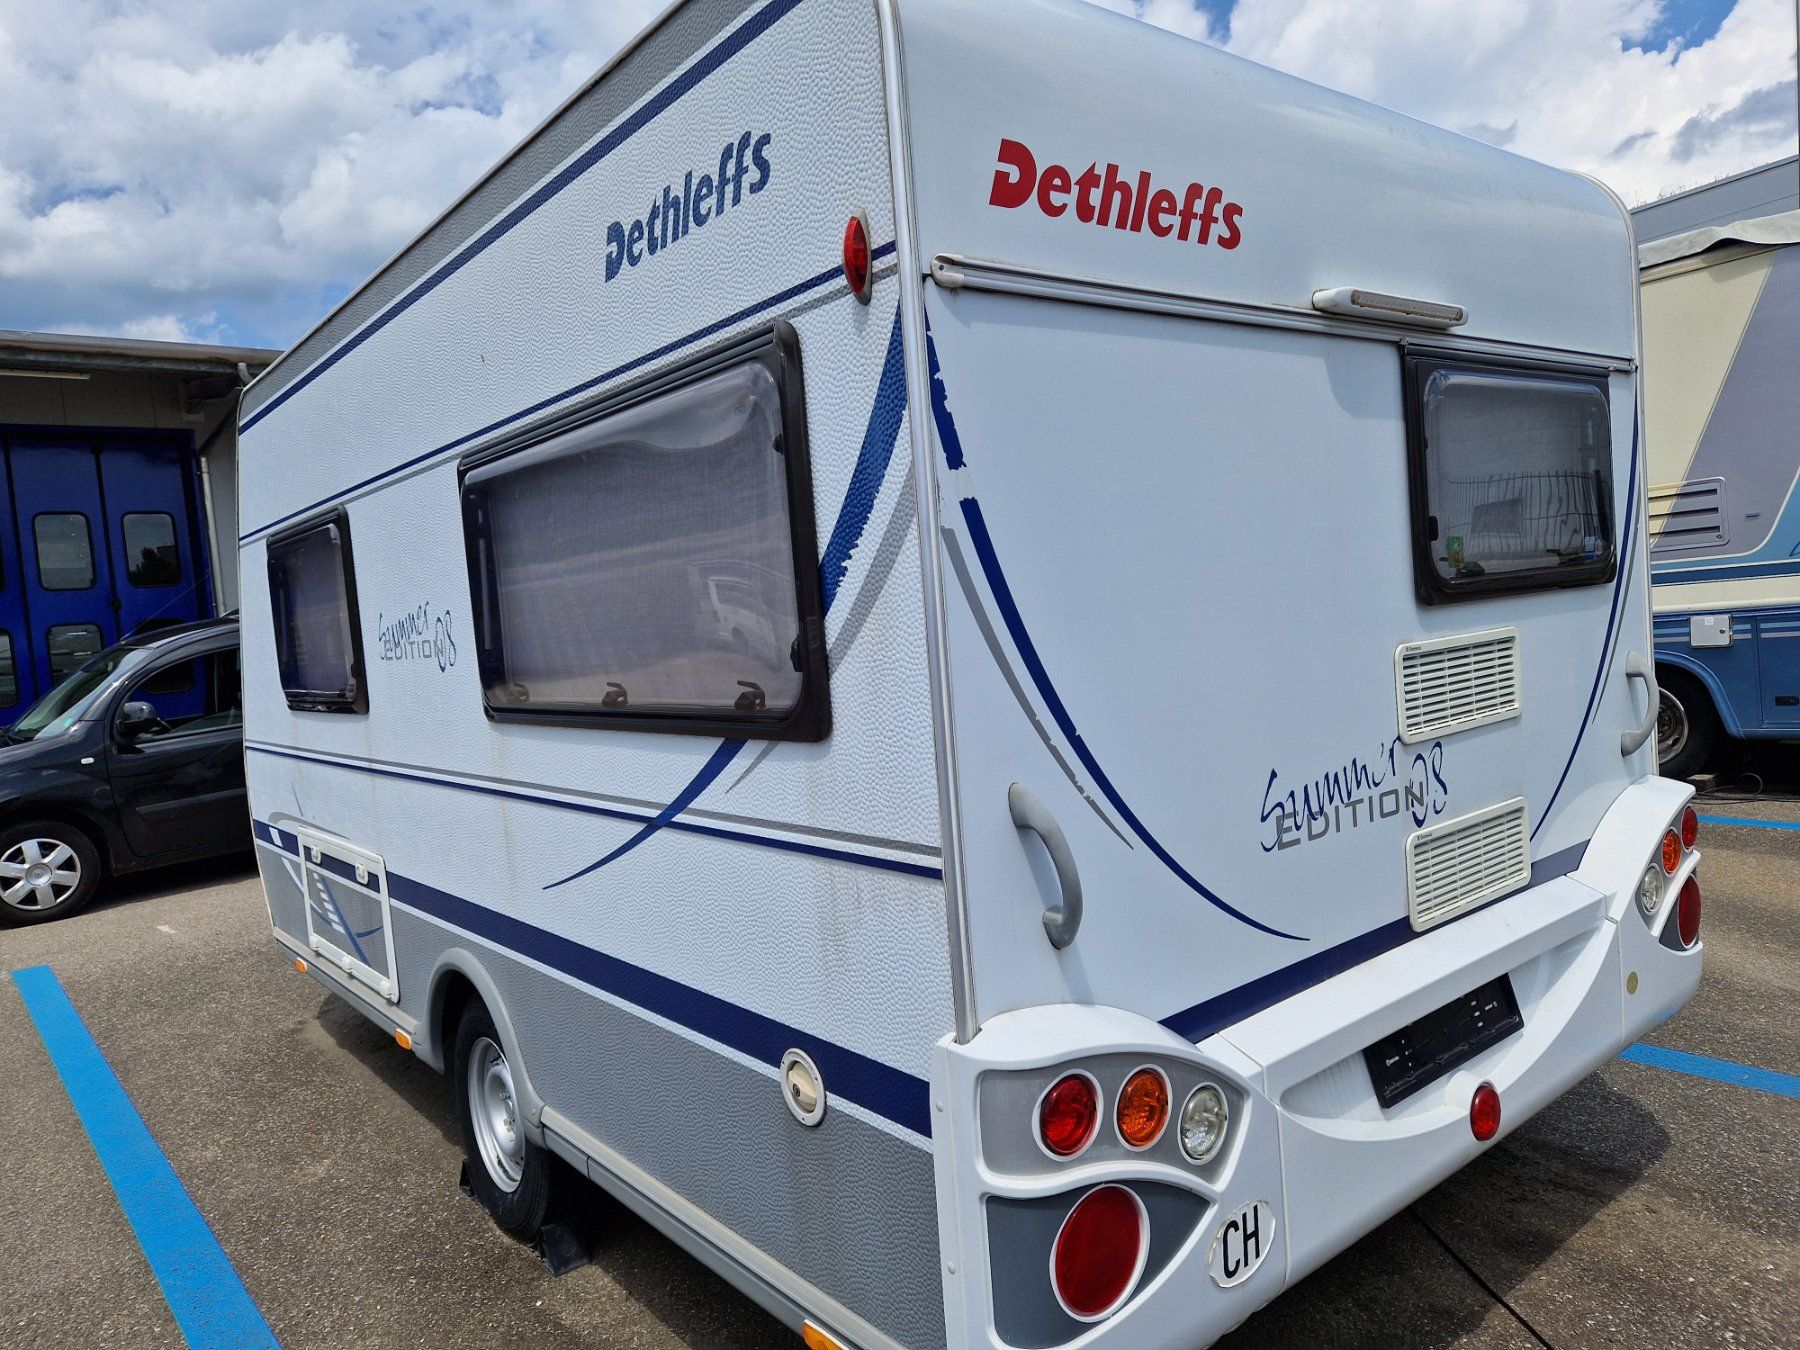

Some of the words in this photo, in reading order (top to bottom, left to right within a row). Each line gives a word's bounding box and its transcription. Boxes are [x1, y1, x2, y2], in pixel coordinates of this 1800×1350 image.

[605, 130, 771, 283] Dethleffs
[989, 138, 1244, 250] Dethleffs
[384, 638, 446, 661] EDITION
[1275, 781, 1425, 851] EDITION
[1222, 1204, 1260, 1279] CH
